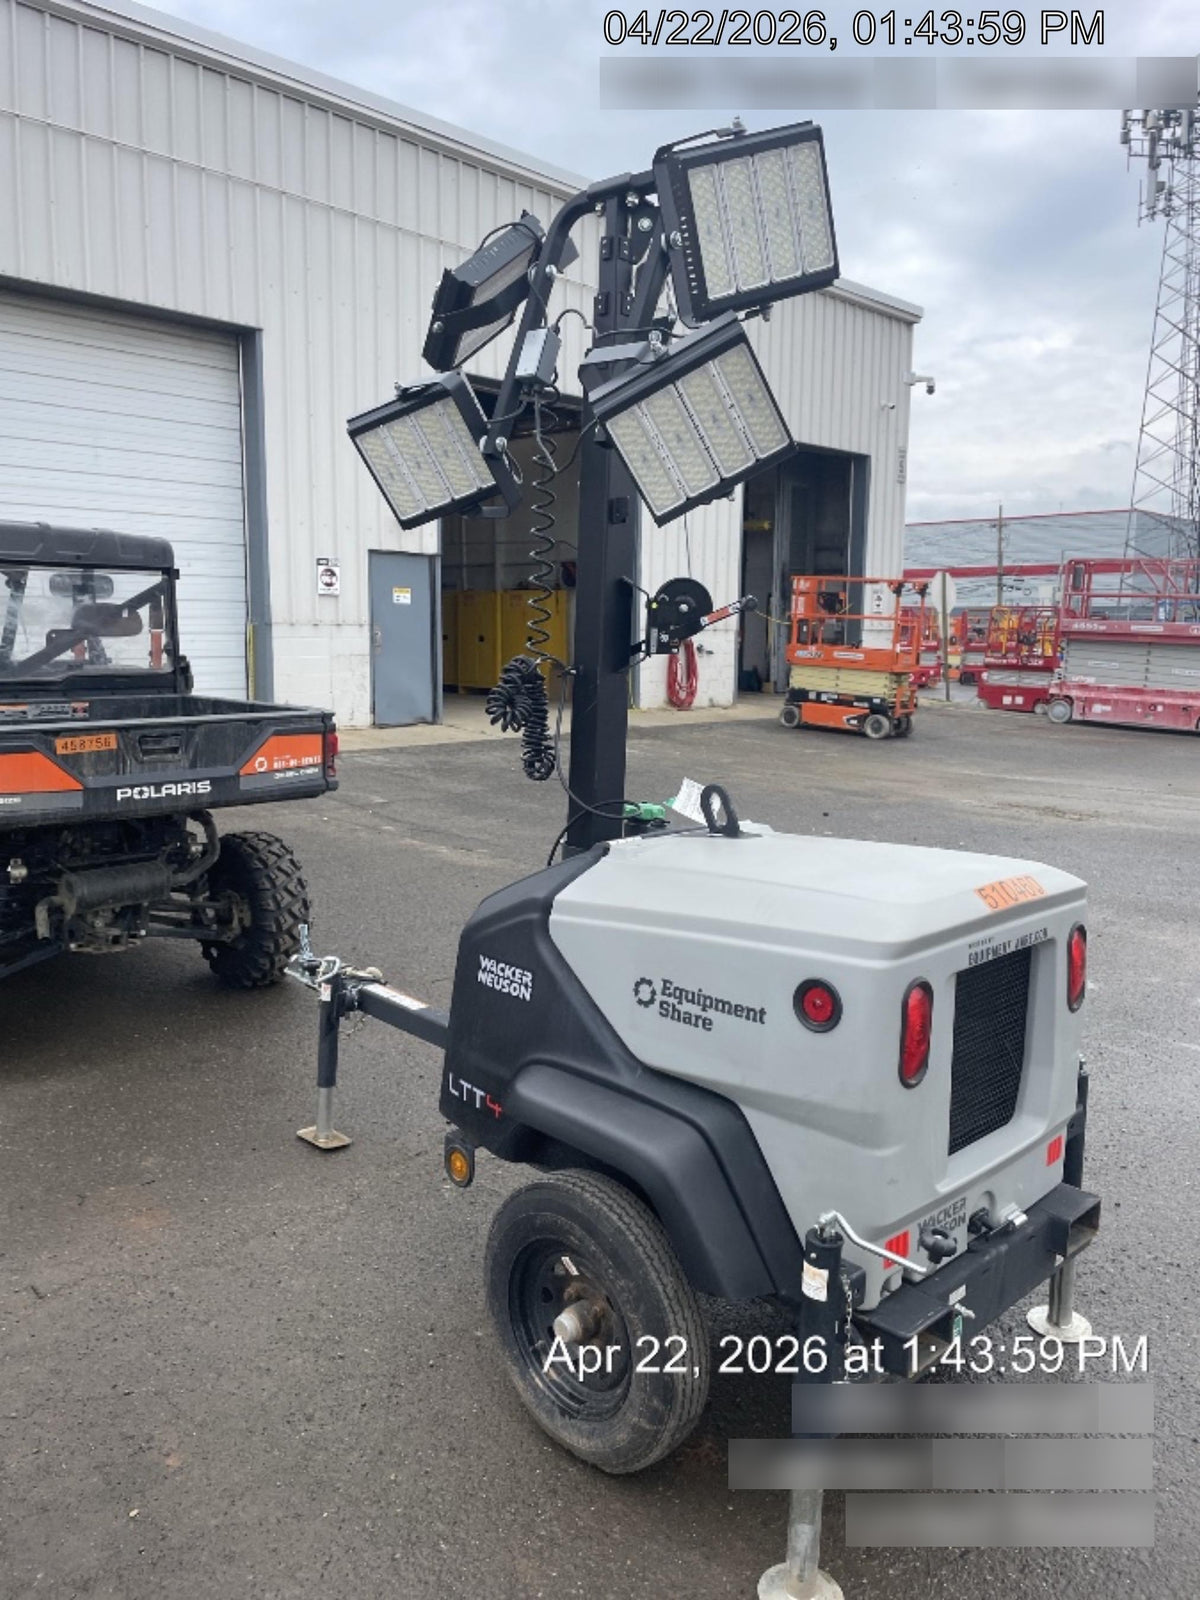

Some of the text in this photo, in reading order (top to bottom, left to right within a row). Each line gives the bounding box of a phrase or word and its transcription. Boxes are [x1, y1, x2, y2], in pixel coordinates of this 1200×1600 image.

[116, 780, 212, 801] POLARIS
[478, 970, 532, 1001] NEUSON
[479, 955, 532, 986] WACKER
[659, 1001, 713, 1032] Share
[661, 979, 767, 1025] Equipment
[449, 1072, 502, 1118] LTT4
